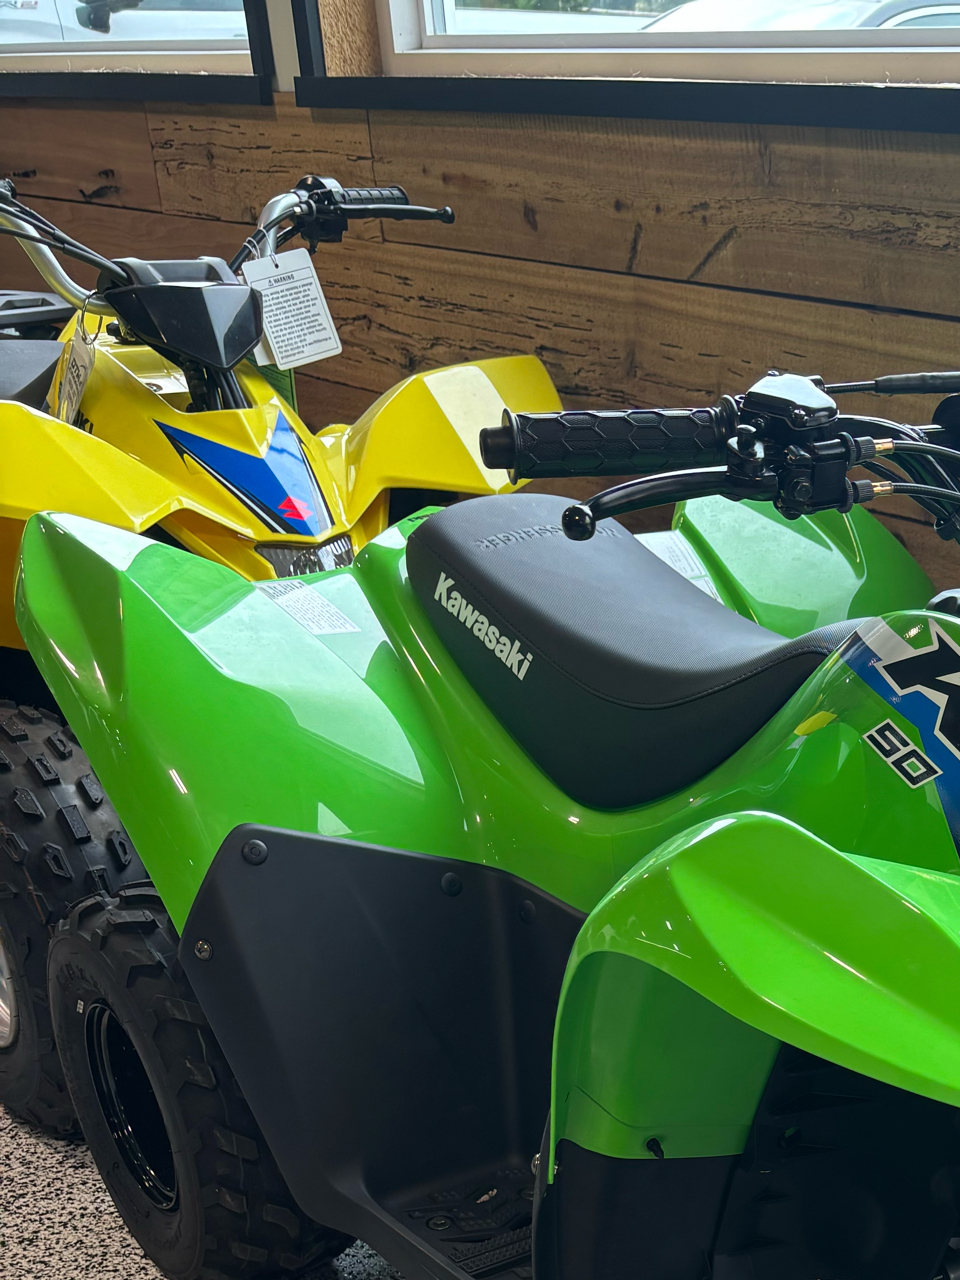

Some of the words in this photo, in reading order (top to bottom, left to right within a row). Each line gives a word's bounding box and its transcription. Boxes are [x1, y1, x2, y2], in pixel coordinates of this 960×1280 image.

[273, 274, 295, 284] WARNING
[434, 572, 534, 681] Kawasaki
[863, 719, 943, 789] 50
